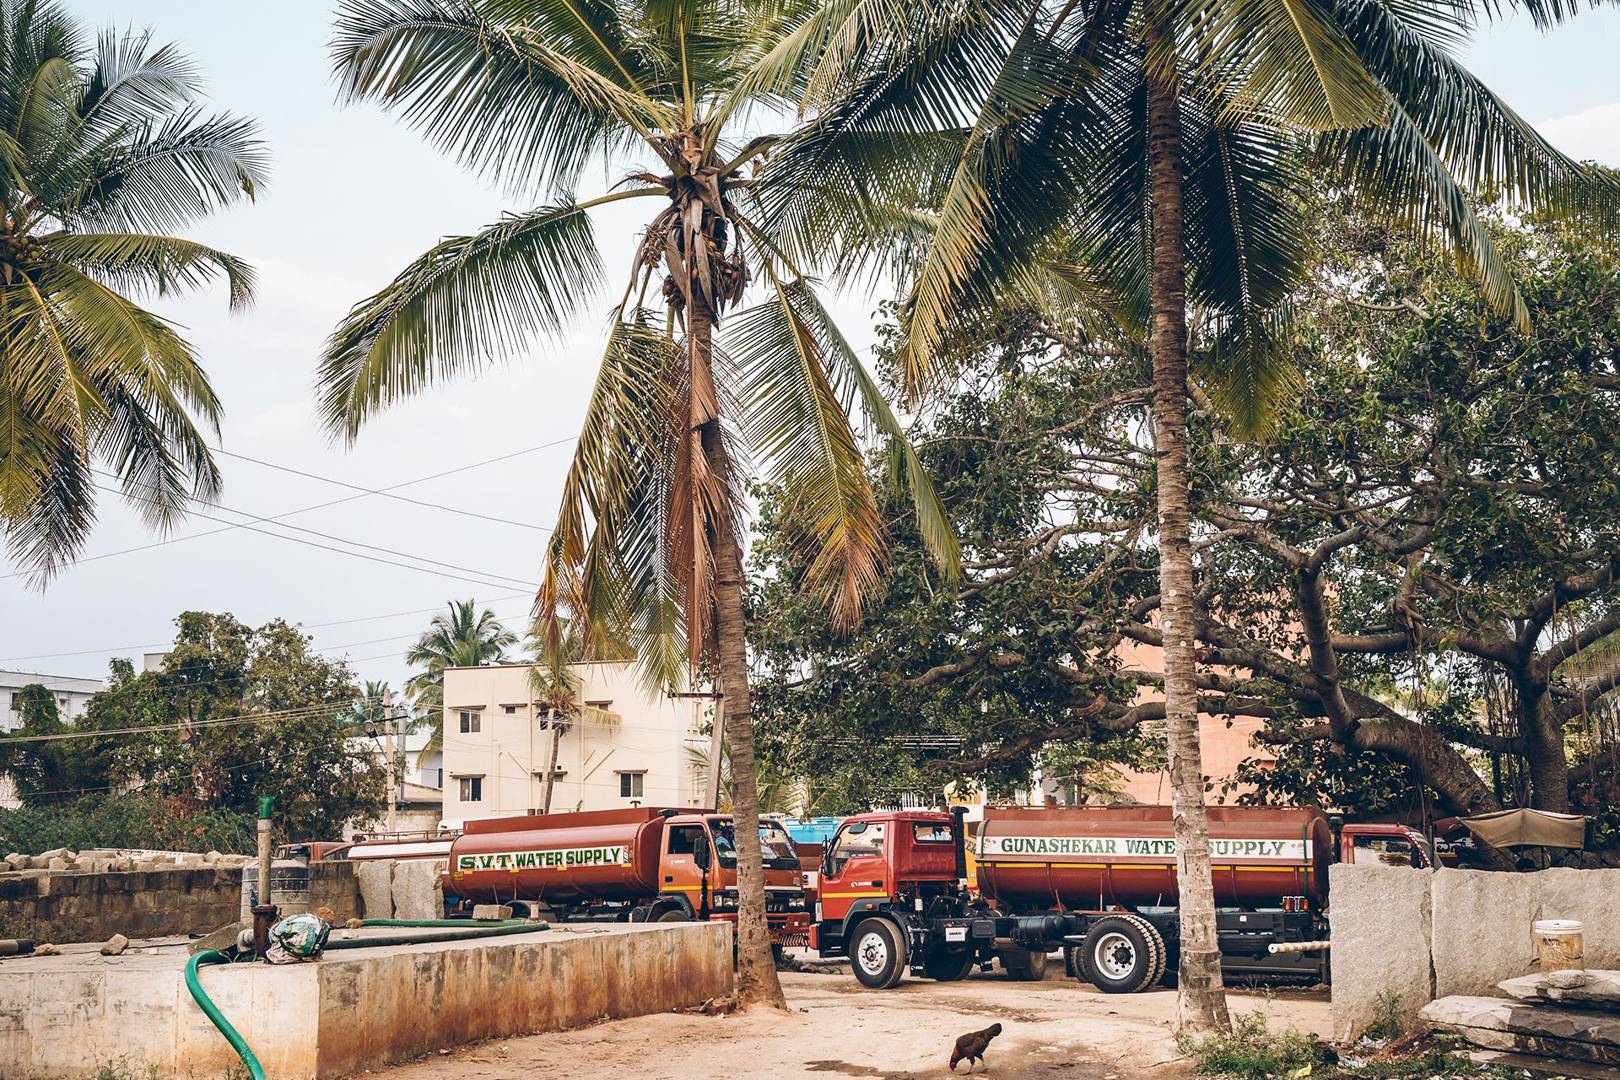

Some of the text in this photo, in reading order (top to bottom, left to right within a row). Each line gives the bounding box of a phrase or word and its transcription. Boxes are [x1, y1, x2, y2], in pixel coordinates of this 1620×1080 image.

[1001, 838, 1117, 853] GUNASHEKAR
[1126, 840, 1176, 855] WATE
[515, 851, 563, 867] WATER
[565, 848, 621, 865] SUPPLY
